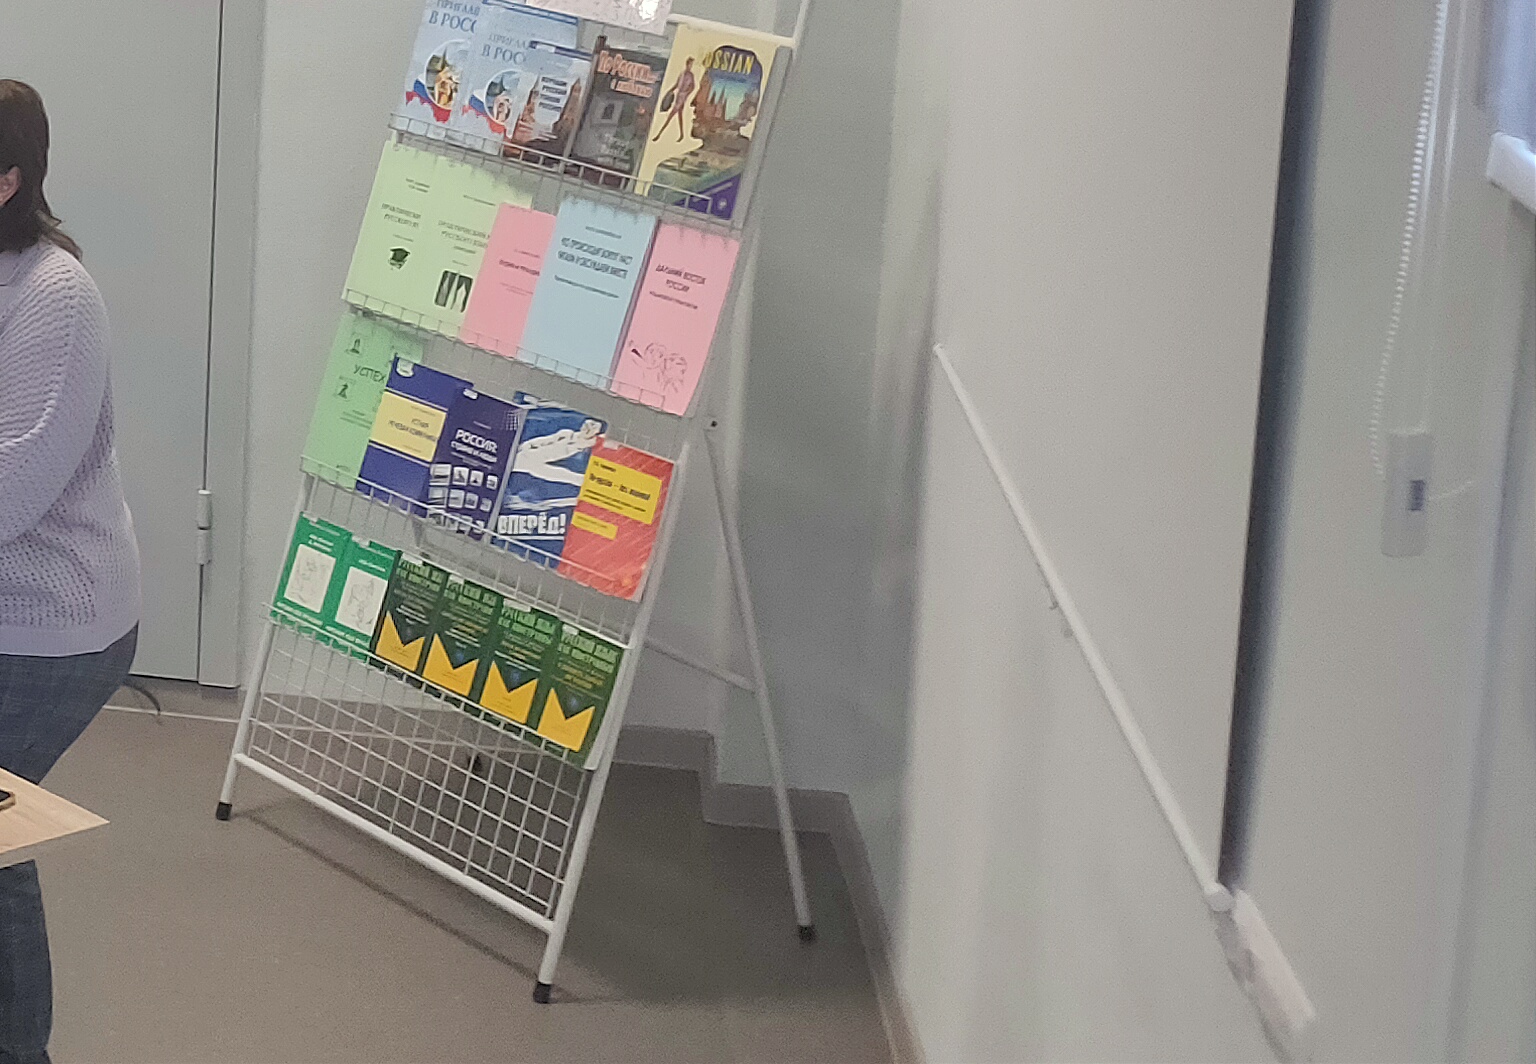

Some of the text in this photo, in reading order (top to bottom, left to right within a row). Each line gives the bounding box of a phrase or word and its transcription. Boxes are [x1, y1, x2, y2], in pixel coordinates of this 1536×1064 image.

[429, 10, 439, 25] В
[482, 44, 492, 57] В
[702, 49, 755, 75] USSIAN
